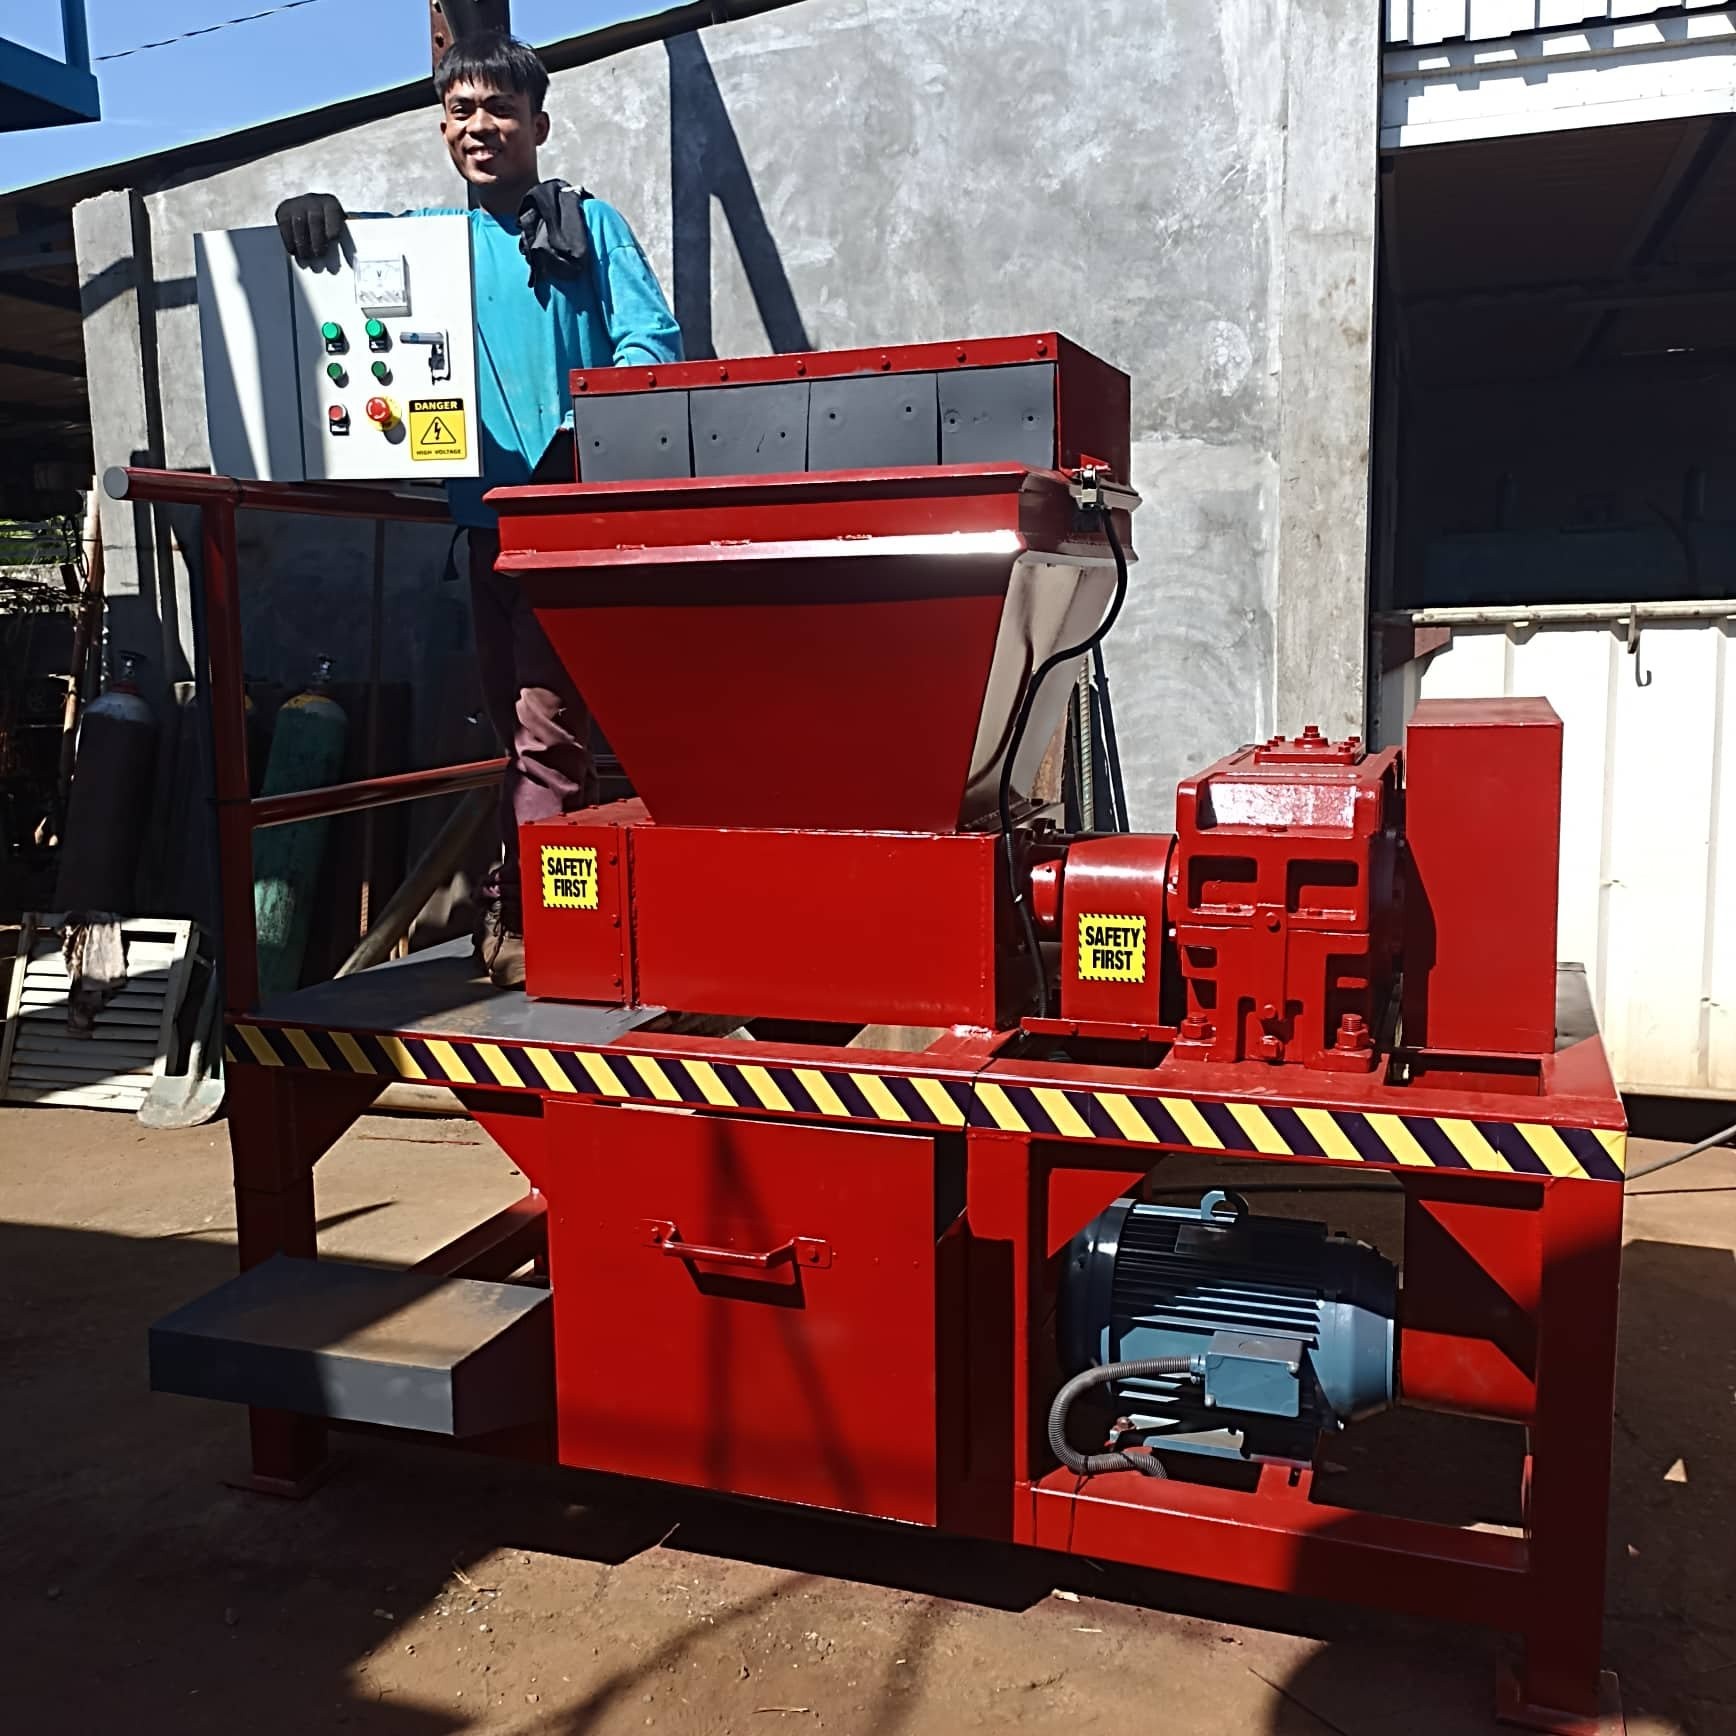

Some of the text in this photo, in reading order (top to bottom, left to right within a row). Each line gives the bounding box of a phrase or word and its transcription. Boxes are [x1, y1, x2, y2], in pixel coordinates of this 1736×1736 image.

[414, 401, 458, 411] DANGER
[547, 857, 592, 877] SAFETY
[554, 878, 587, 898] FIRST
[1085, 925, 1140, 948] SAFETY
[1092, 948, 1133, 970] FIRST
